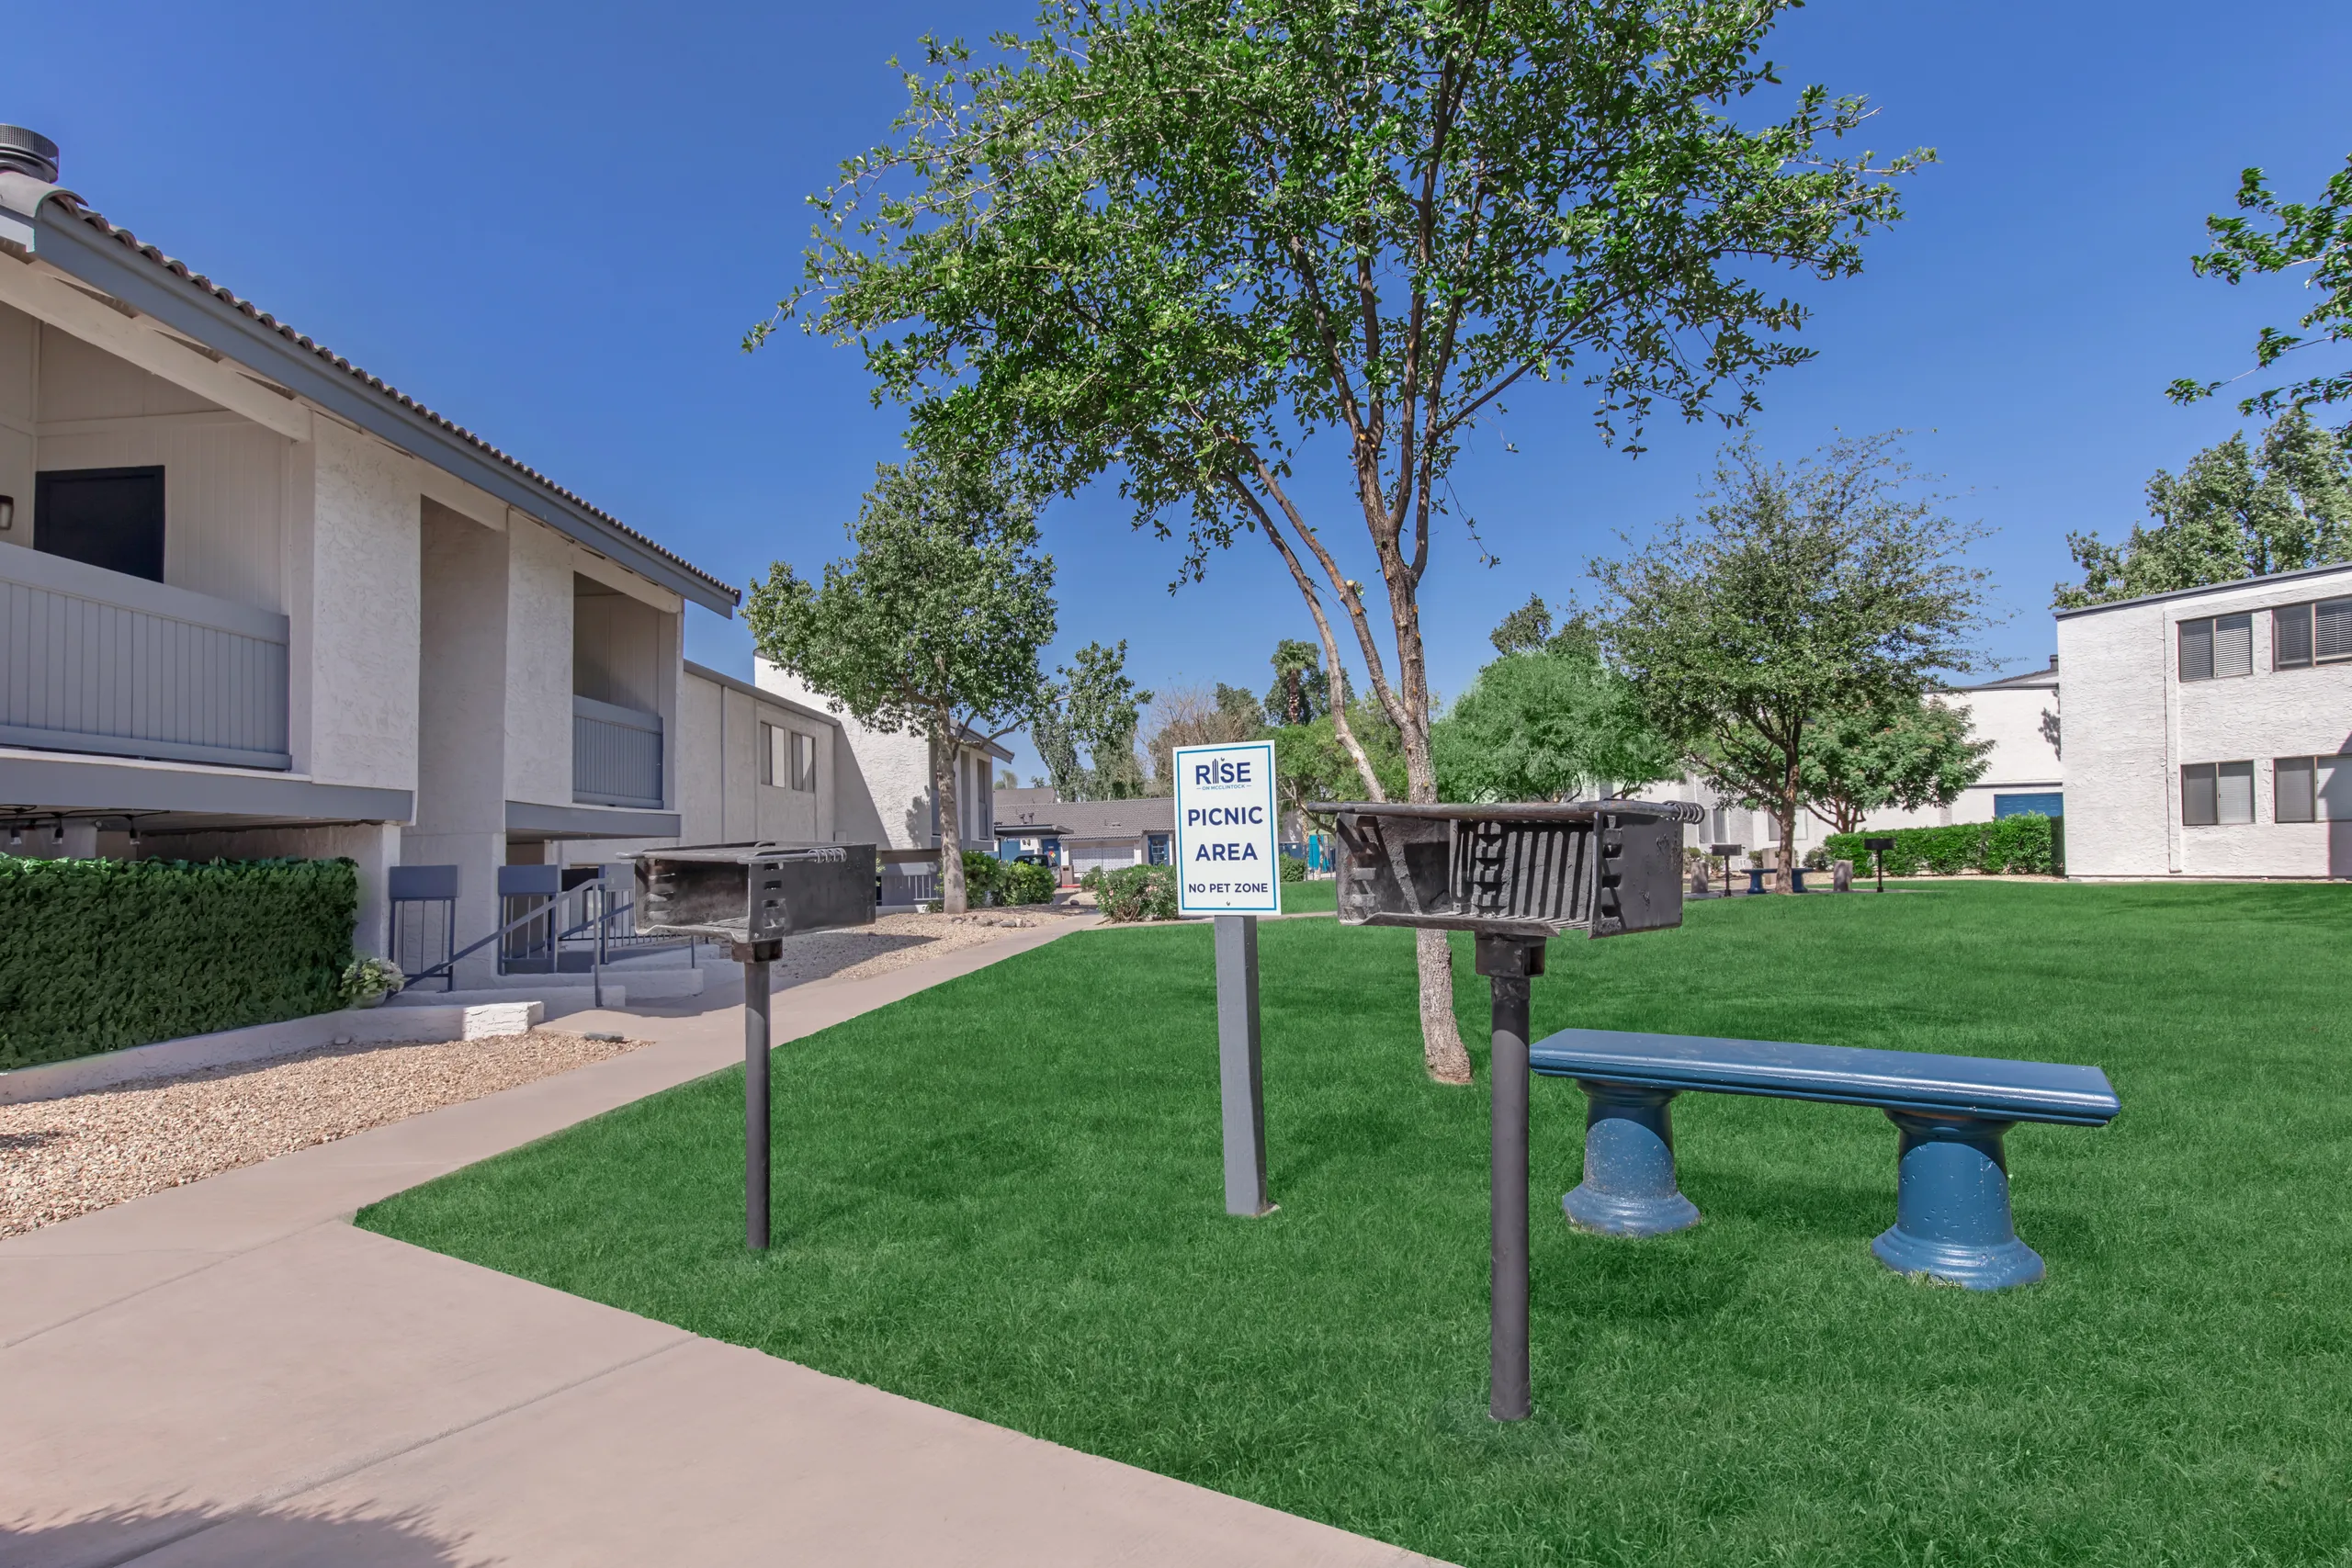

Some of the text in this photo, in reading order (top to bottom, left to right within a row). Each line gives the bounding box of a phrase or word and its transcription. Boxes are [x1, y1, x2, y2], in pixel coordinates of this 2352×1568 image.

[1195, 759, 1251, 784] RISE
[1188, 807, 1263, 827] PICNIC
[1195, 842, 1259, 862] AREA
[1189, 883, 1268, 893] NO PET ZONE
